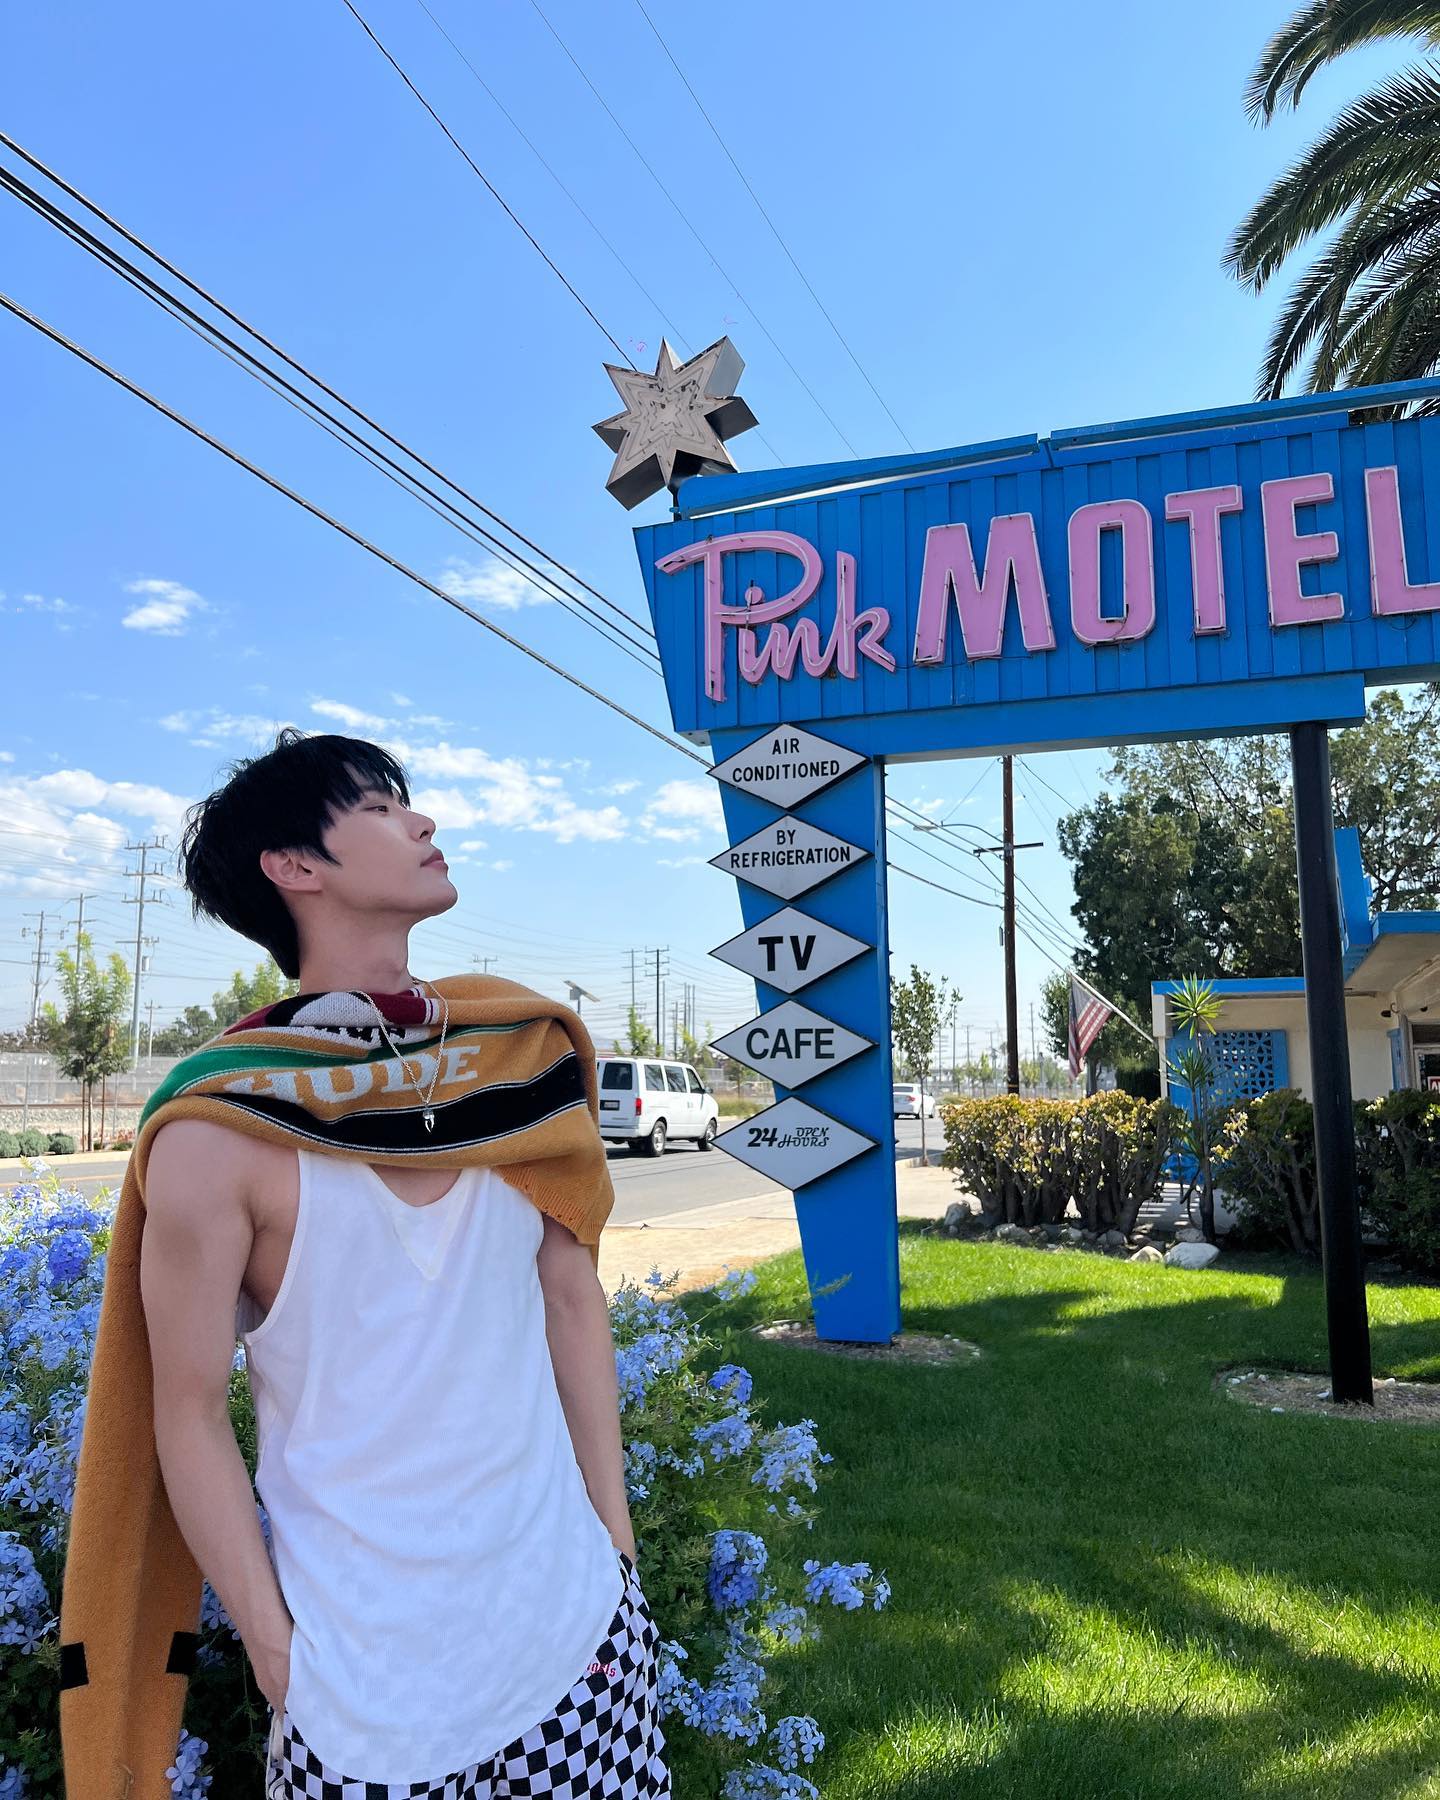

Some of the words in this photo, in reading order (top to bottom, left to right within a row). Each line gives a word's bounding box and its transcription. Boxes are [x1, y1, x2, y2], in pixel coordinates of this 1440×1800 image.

[654, 530, 896, 702] Pink
[913, 465, 1440, 665] MOTEL
[772, 738, 800, 755] AIR
[732, 760, 840, 783] CONDITIONED
[776, 829, 797, 845] BY
[731, 846, 851, 869] REFRIGERATION
[758, 935, 816, 971] TV
[746, 1028, 835, 1060] CAFE
[747, 1127, 778, 1147] 24
[778, 1134, 829, 1148] HOURS
[796, 1127, 829, 1137] OPEN
